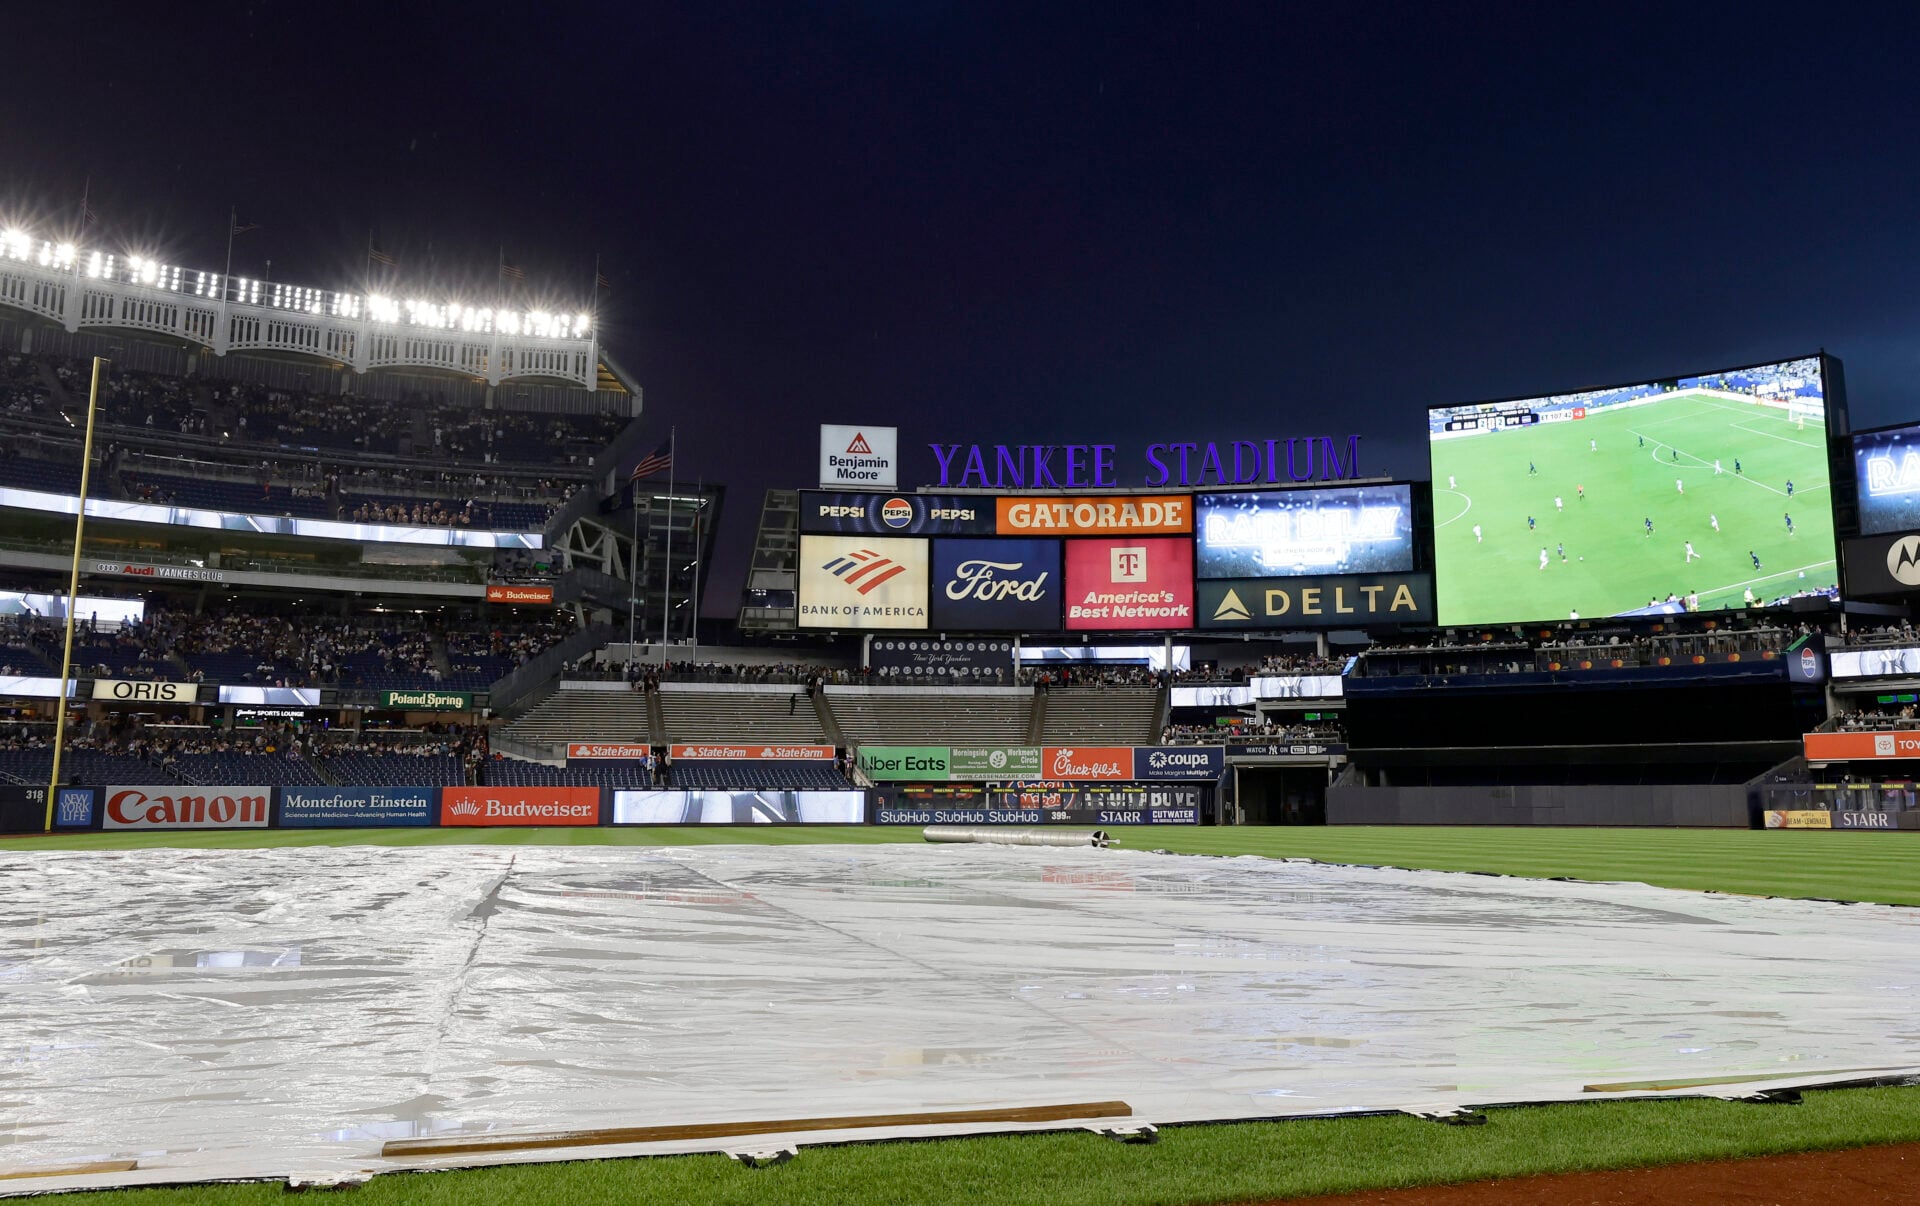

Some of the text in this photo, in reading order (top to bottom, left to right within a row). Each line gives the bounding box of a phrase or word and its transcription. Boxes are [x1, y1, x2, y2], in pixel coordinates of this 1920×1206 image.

[829, 456, 888, 470] Benjamin
[928, 434, 1362, 489] YANKEE STADIUM
[836, 468, 878, 480] Moore
[820, 506, 864, 518] PEPSI
[930, 509, 974, 520] PEPSI
[1008, 502, 1182, 528] GATORADE
[1206, 505, 1400, 543] RAIN DELAY
[122, 564, 223, 580] Audi YANKEES CLUB
[946, 560, 1048, 602] Ford
[506, 591, 550, 600] Budweiser
[1265, 584, 1418, 616] DELTA
[802, 605, 924, 616] BANK OF AMERICA
[1070, 604, 1190, 618] Best Network
[928, 654, 943, 664] York
[114, 681, 176, 700] ORIS
[389, 692, 463, 708] Poland Spring
[953, 749, 988, 758] Morningside
[862, 755, 946, 771] Uber Eats
[1054, 752, 1121, 778] Chick-fil-A
[1168, 754, 1208, 768] coupa
[26, 790, 43, 799] 318
[64, 794, 88, 802] NEW
[286, 795, 427, 808] Montefiore Einstein
[61, 802, 89, 812] YORK
[107, 790, 265, 824] Canon
[484, 800, 591, 817] Budweiser
[63, 811, 86, 821] LIFE
[880, 811, 1039, 823] StubHub StubHub StubHub
[1051, 812, 1066, 820] 399
[1101, 811, 1140, 822] STARR
[1843, 812, 1888, 827] STARR
